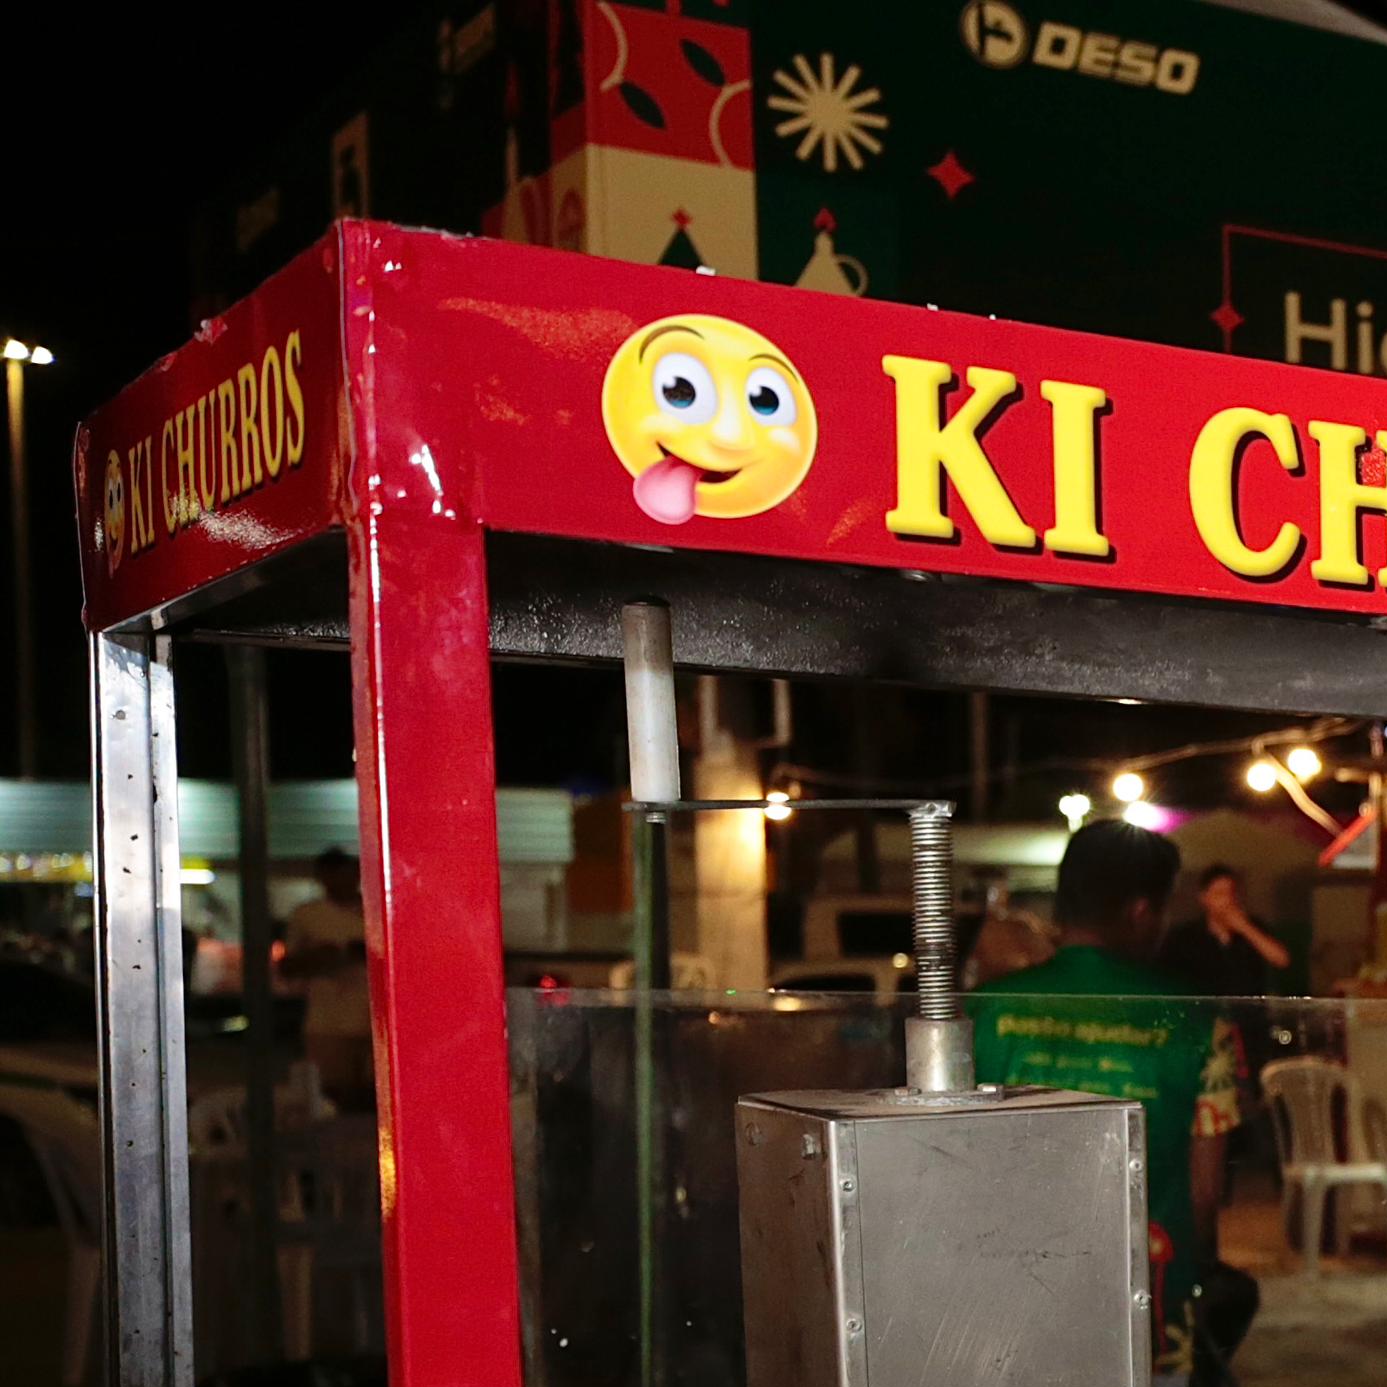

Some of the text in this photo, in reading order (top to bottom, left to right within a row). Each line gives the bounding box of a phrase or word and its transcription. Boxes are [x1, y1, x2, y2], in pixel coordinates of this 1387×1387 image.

[1032, 21, 1200, 95] DESO
[128, 328, 306, 555] KI CHURROS
[882, 353, 1111, 560] KI
